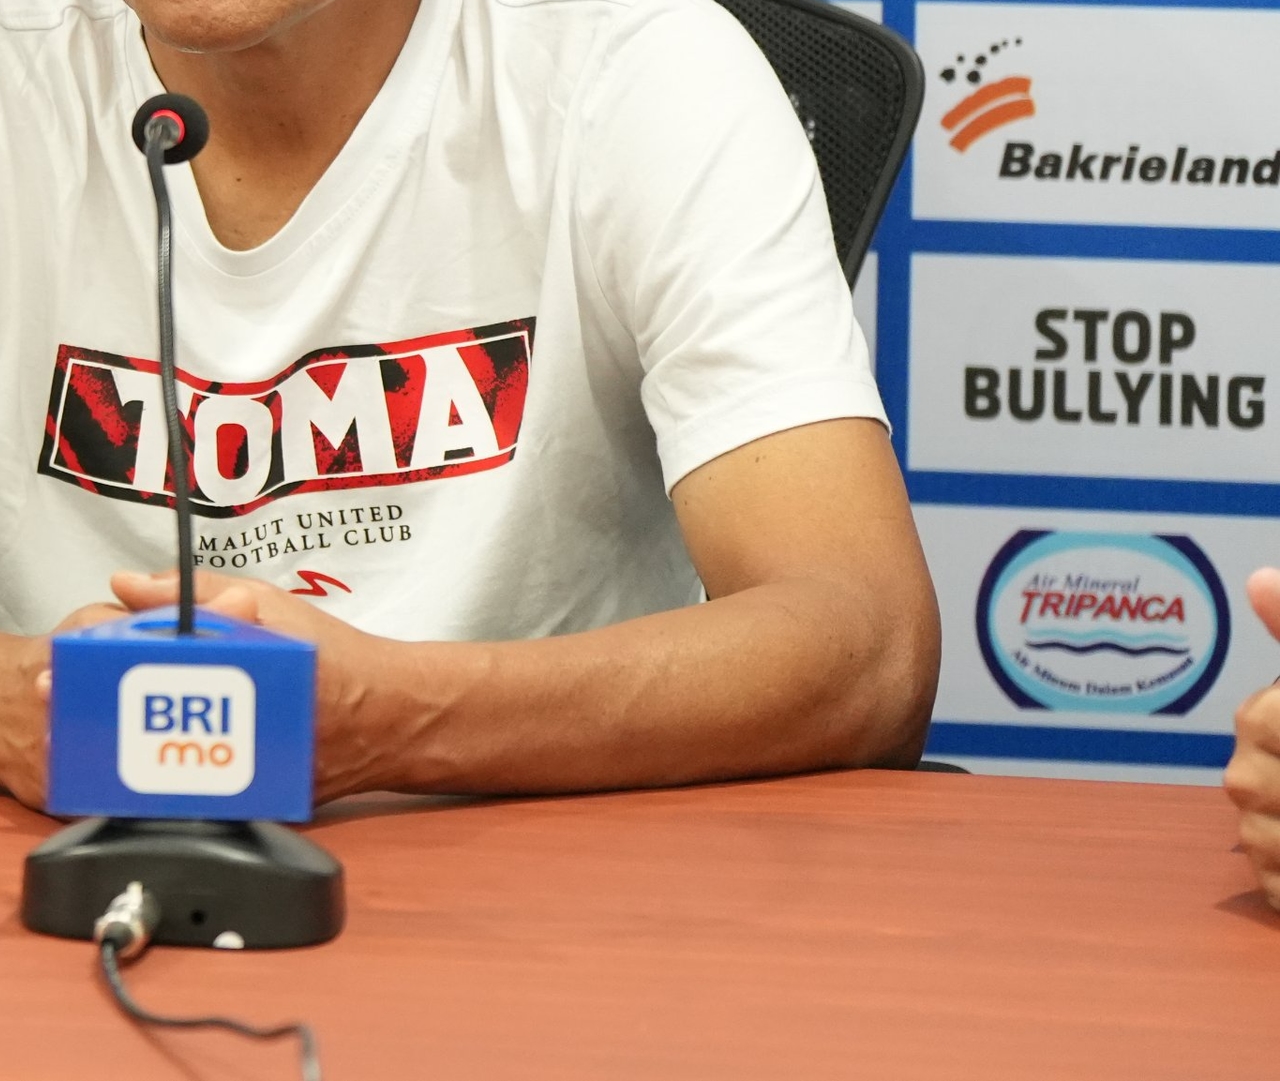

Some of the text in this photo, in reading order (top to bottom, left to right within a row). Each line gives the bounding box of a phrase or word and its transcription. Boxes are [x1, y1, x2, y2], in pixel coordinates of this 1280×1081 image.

[998, 142, 1280, 186] Bakrieland
[1035, 309, 1197, 367] STOP
[964, 367, 1267, 431] BULLYING
[104, 344, 502, 506] TOMA
[193, 524, 412, 569] FOOTBALL CLUB
[198, 504, 403, 552] MALUT UNITED
[1026, 573, 1141, 594] Air Mineral
[1020, 591, 1186, 625] TRIPANCA
[144, 695, 230, 734] BRI
[157, 740, 234, 767] mo
